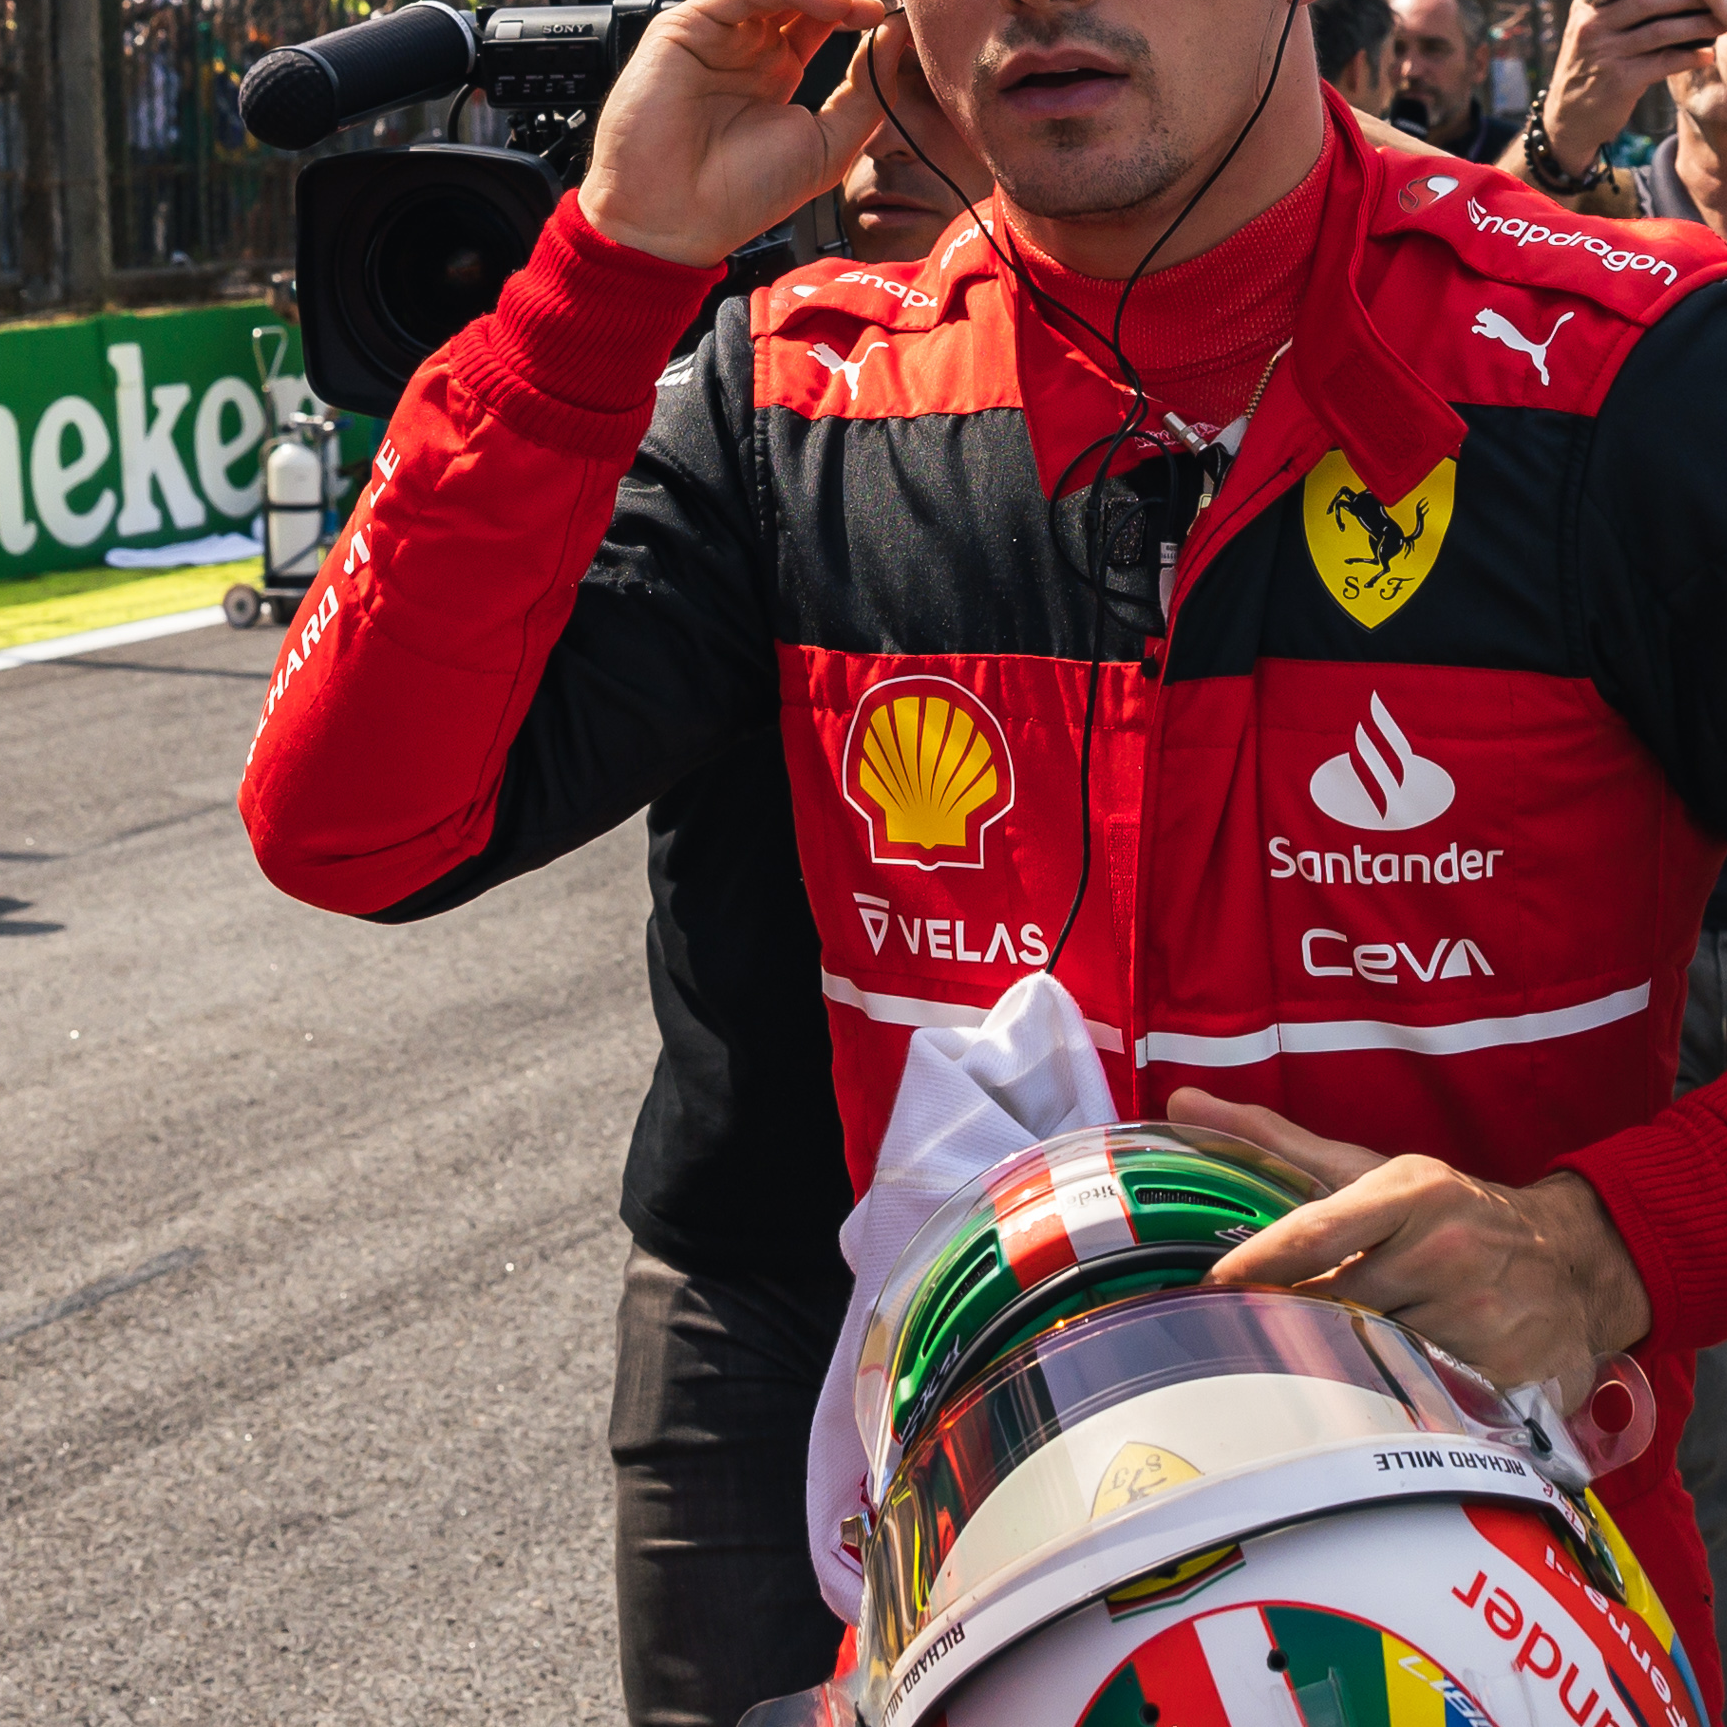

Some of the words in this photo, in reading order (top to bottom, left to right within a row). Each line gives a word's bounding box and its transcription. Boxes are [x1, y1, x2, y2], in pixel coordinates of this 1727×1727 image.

[542, 24, 584, 33] SONY
[1467, 196, 1678, 286] Snapdragon
[1342, 575, 1360, 600] S
[1270, 836, 1504, 885] Santander
[897, 915, 1049, 966] VELAS
[1374, 1449, 1444, 1472] MILLE
[1431, 1451, 1527, 1477] RICHARD
[903, 1623, 966, 1695] RICHARD
